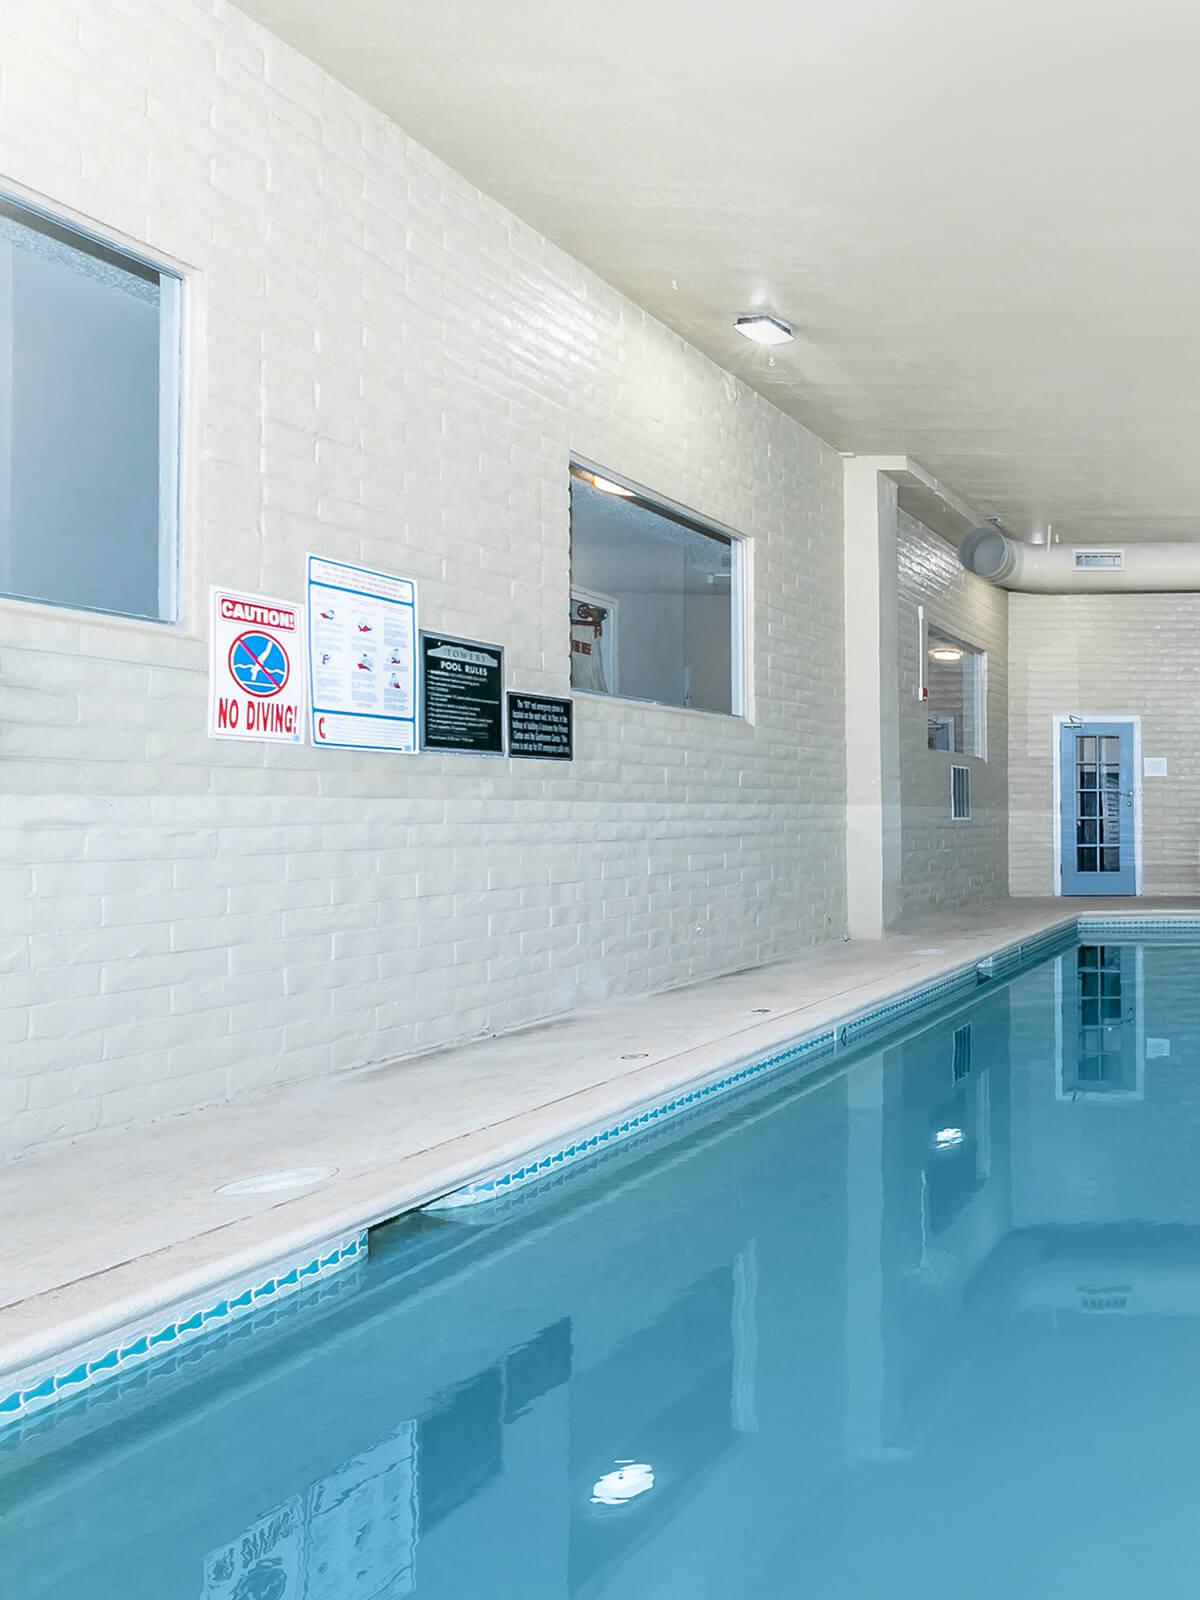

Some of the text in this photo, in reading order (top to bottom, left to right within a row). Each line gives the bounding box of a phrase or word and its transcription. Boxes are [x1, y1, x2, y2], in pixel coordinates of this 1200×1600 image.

[221, 600, 295, 628] CAUTION!
[440, 660, 463, 672] POOL
[465, 665, 488, 676] RULES
[218, 697, 239, 729] NO
[246, 700, 298, 734] DIVING!
